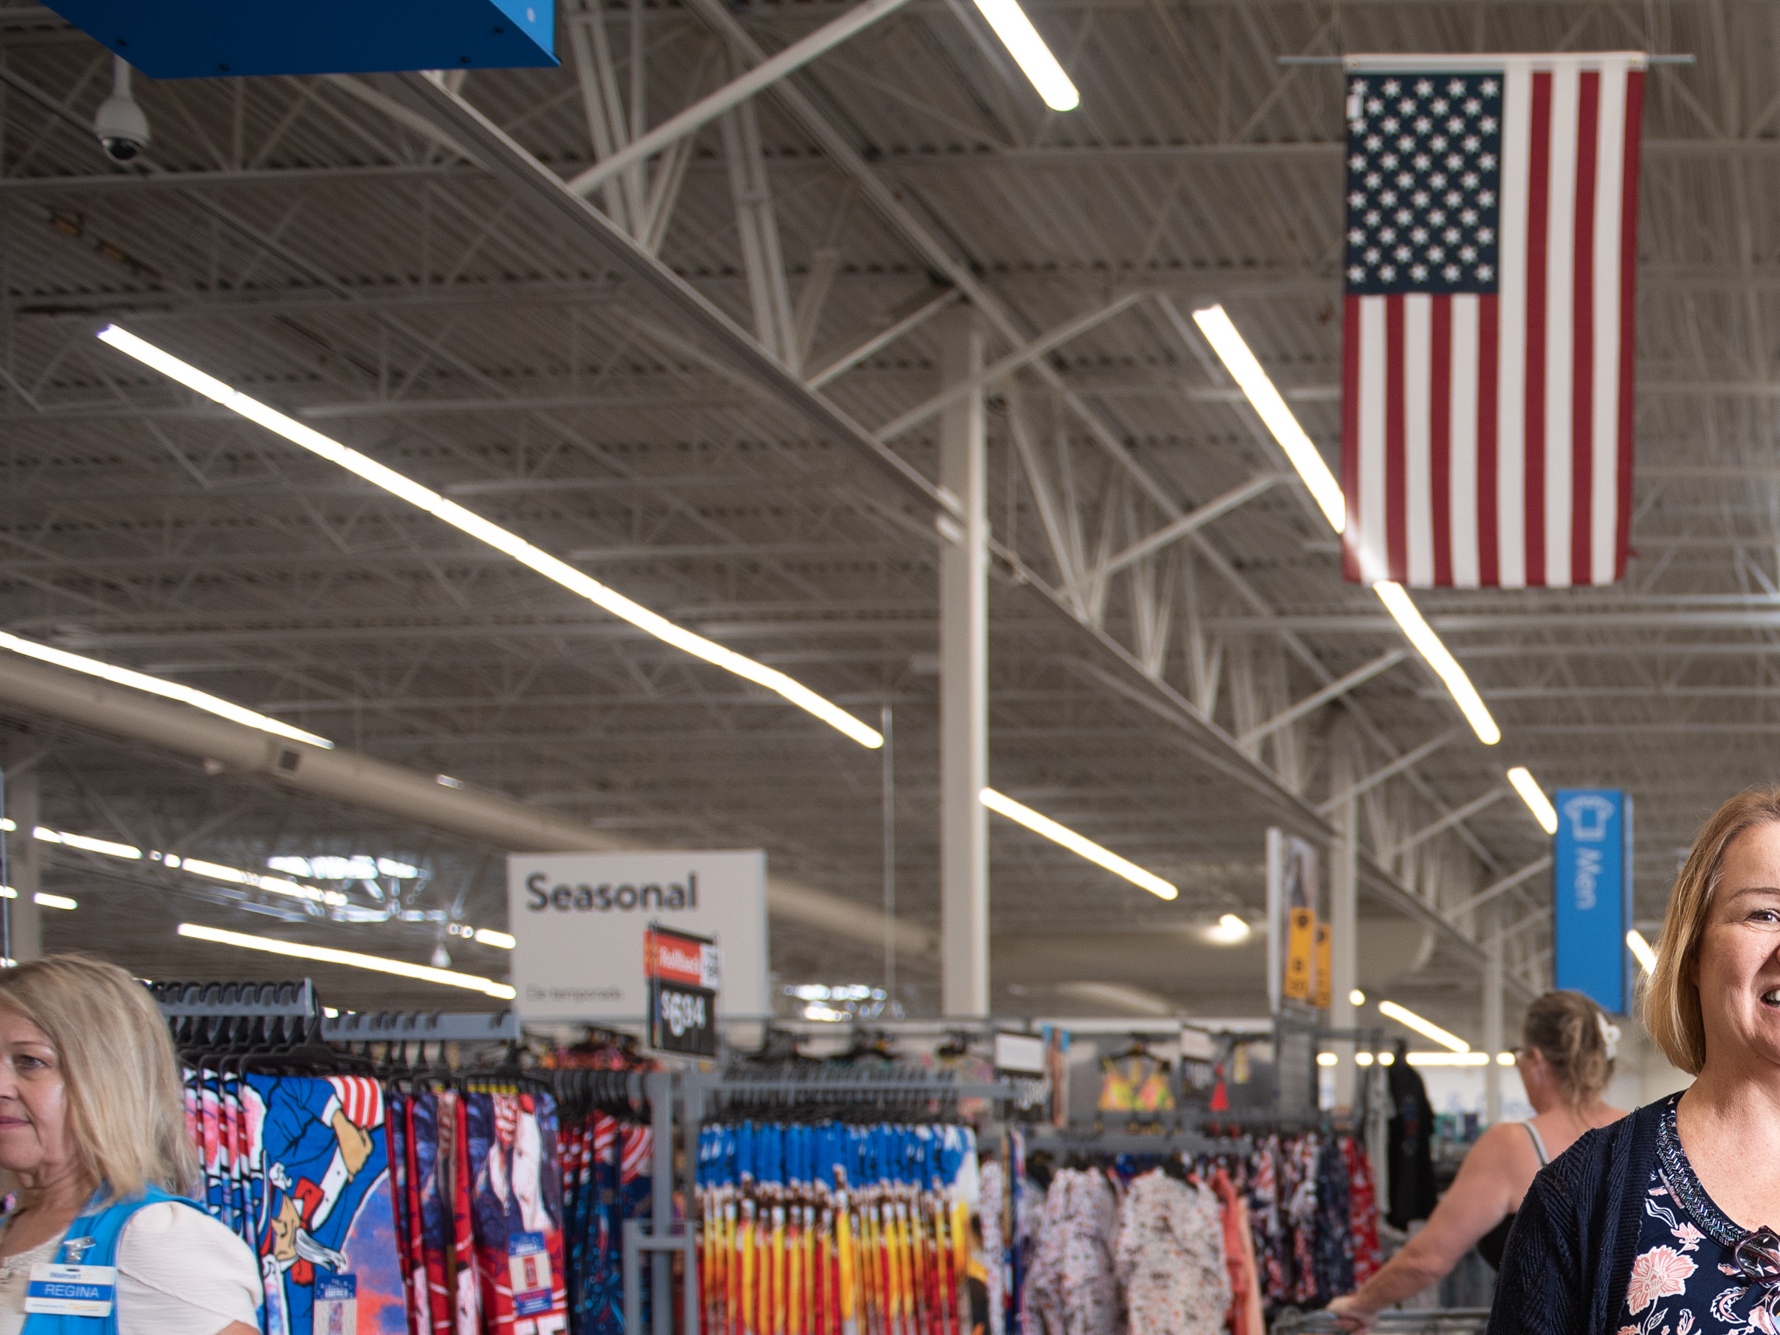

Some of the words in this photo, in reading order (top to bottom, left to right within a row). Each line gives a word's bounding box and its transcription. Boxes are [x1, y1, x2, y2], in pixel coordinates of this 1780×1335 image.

[525, 870, 697, 912] Seasonal
[1574, 846, 1604, 910] Men
[659, 945, 700, 975] Rollback
[44, 1283, 99, 1298] REGINA
